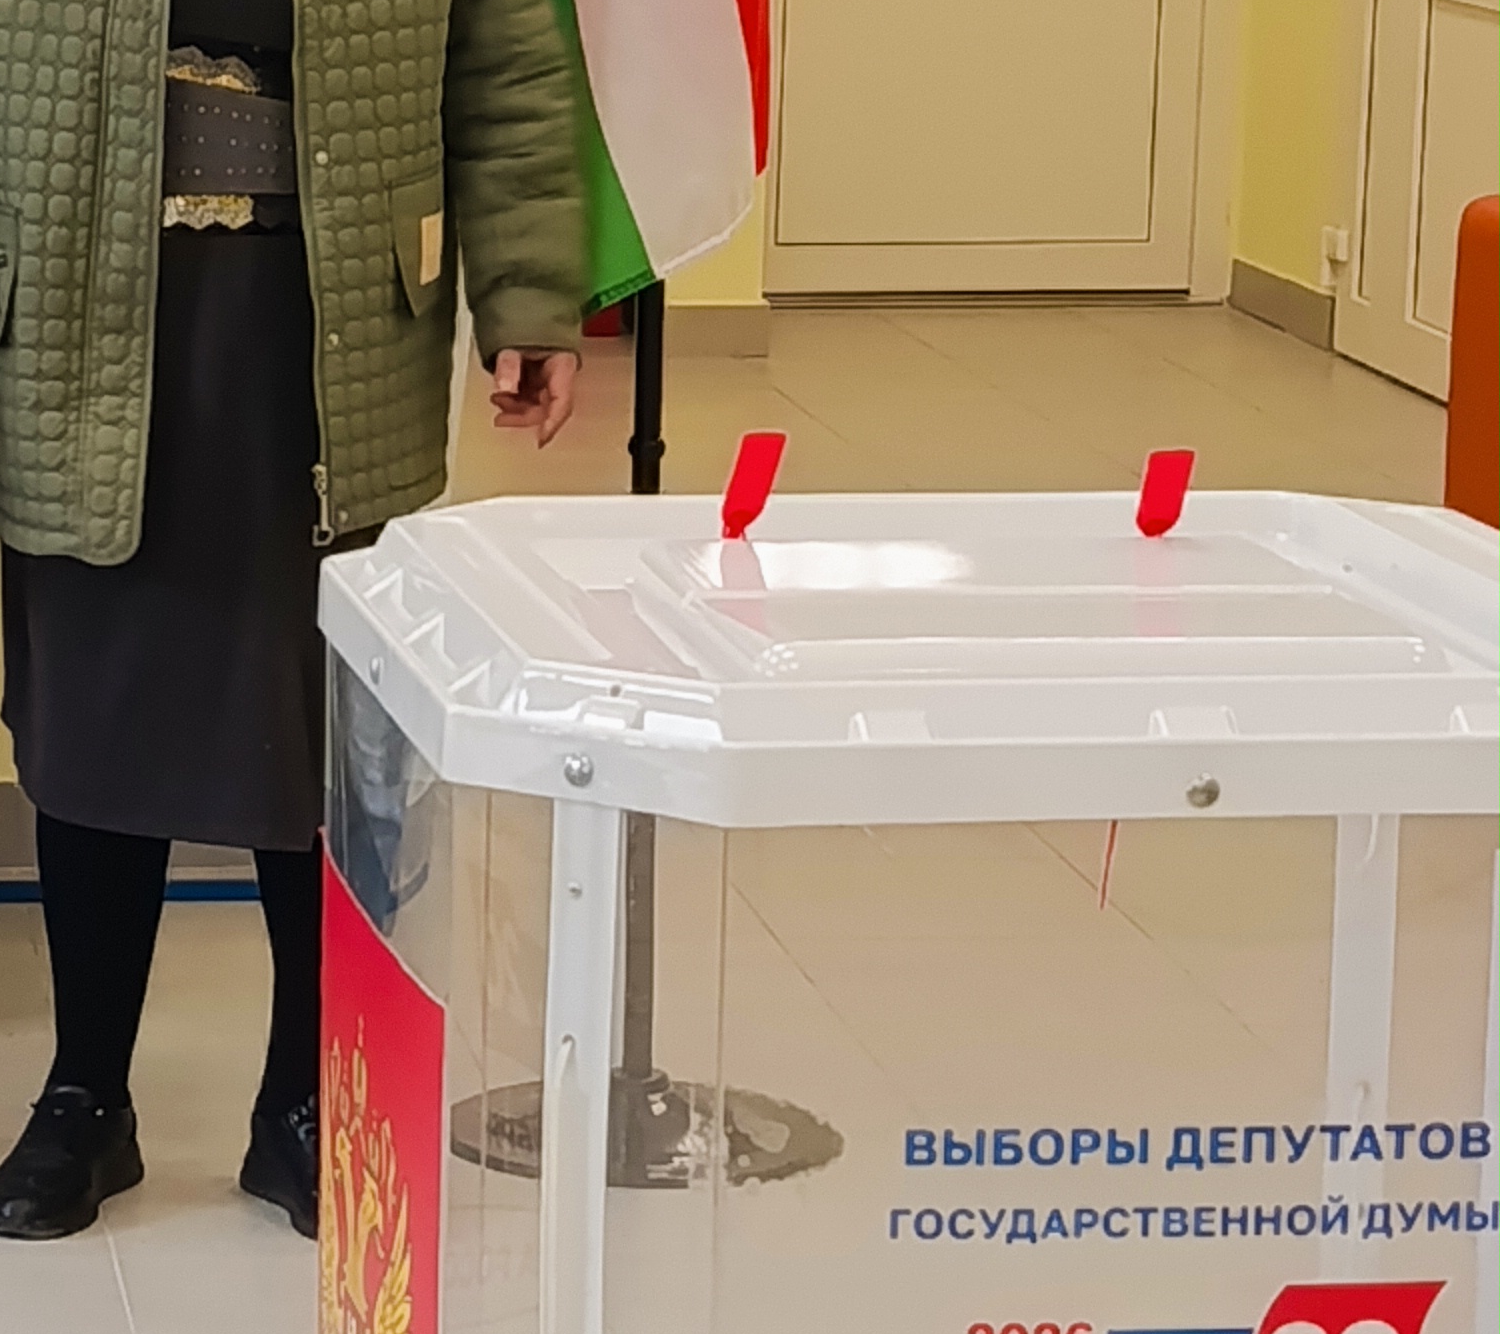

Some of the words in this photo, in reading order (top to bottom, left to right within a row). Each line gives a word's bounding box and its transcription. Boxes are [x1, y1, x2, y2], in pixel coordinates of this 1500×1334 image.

[905, 1128, 1149, 1166] ВЫБОРЫ
[1165, 1121, 1491, 1171] ДЕПУТАТОВ
[889, 1196, 1350, 1244] ГОСУДАРСТВЕННОЙ
[1362, 1201, 1500, 1240] ДУМЫ
